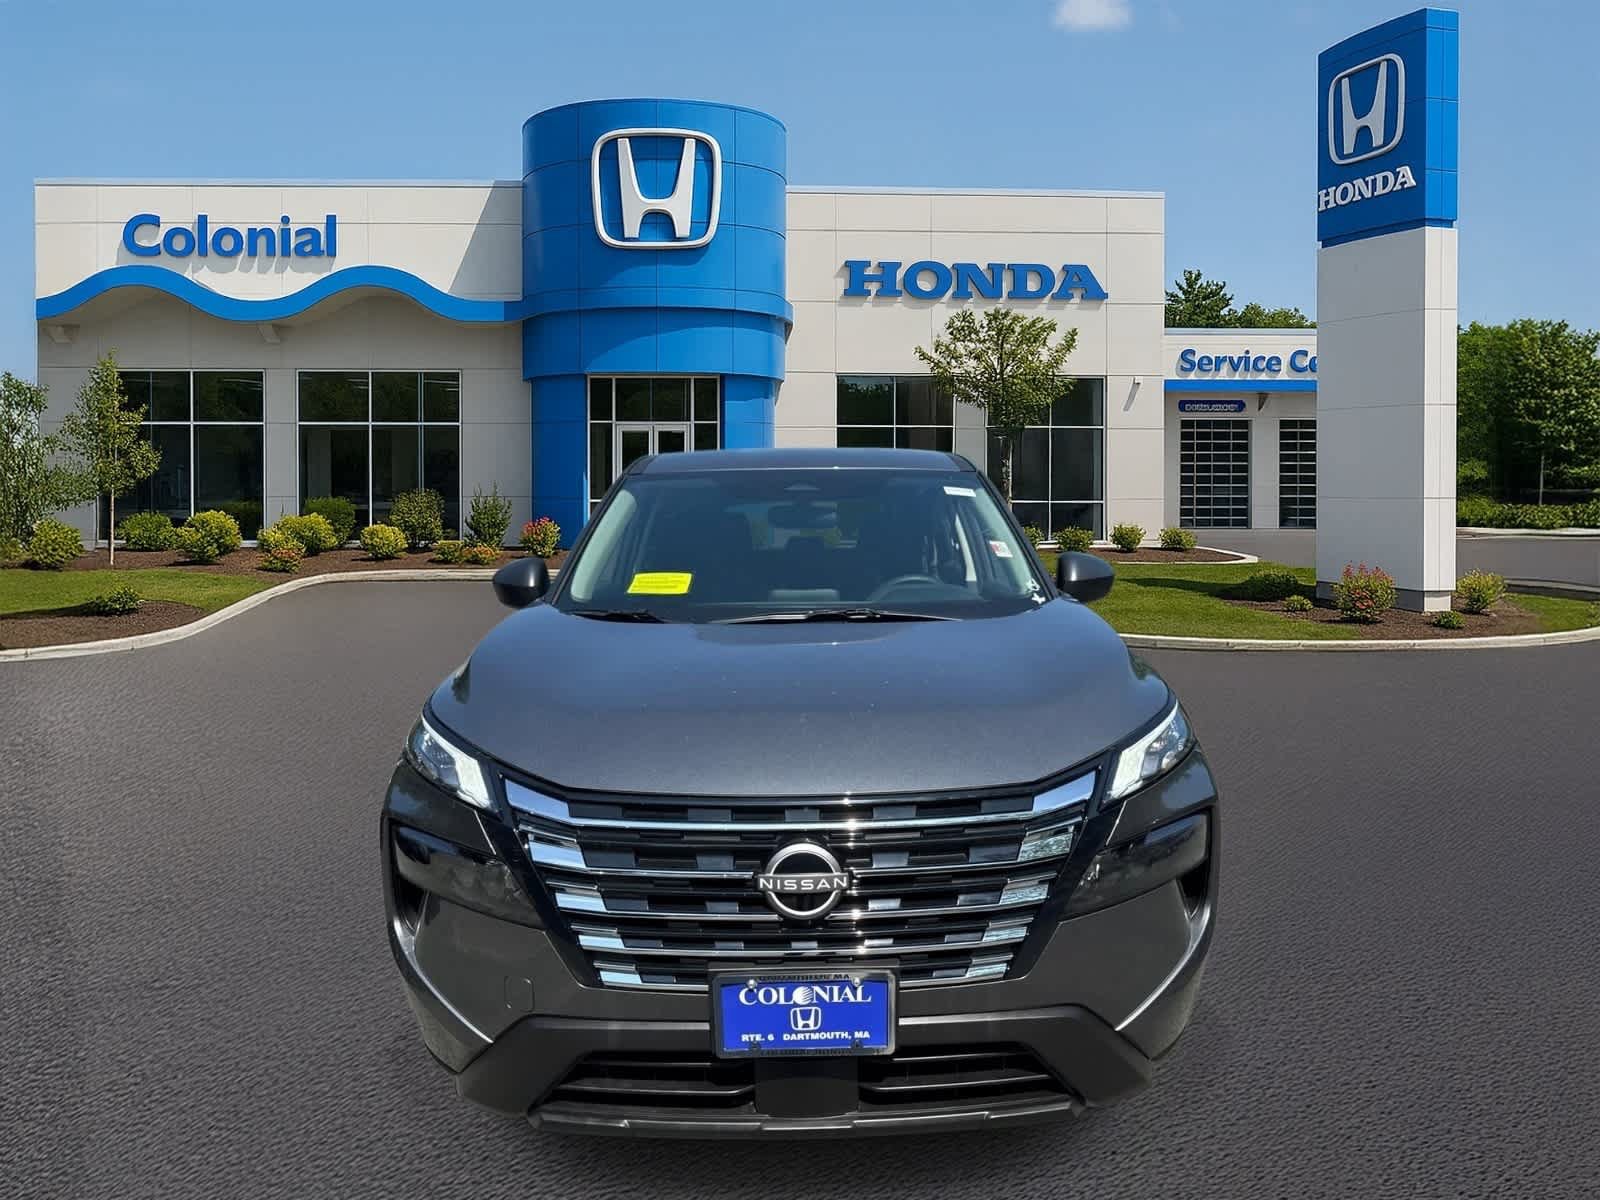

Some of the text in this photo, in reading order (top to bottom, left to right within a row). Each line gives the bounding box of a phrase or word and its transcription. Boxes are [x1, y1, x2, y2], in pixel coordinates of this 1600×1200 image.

[1318, 165, 1417, 212] HONDA
[122, 213, 337, 257] Colonial
[843, 260, 1109, 300] HONDA
[1179, 348, 1282, 373] Service
[759, 876, 847, 891] NISSAN
[739, 985, 872, 1006] COLONIAL
[741, 1030, 871, 1042] RTE. 6 DARTMOUTH, MA
